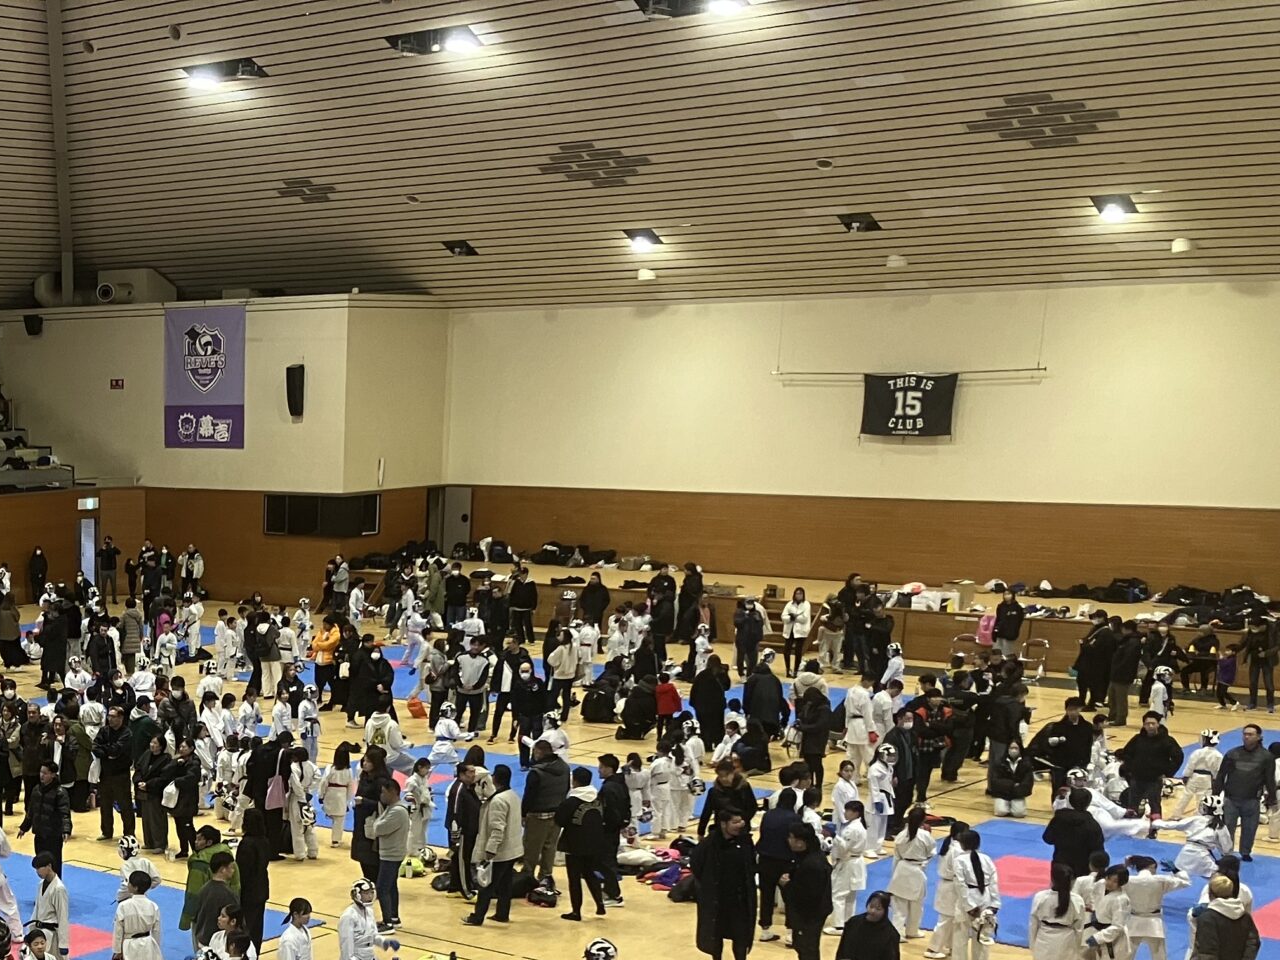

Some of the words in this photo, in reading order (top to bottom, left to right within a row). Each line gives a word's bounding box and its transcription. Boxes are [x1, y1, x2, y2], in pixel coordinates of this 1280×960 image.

[184, 353, 226, 370] REVE'S
[888, 376, 917, 390] THIS
[920, 379, 935, 390] IS
[894, 391, 923, 416] 15
[888, 418, 924, 430] CLUB
